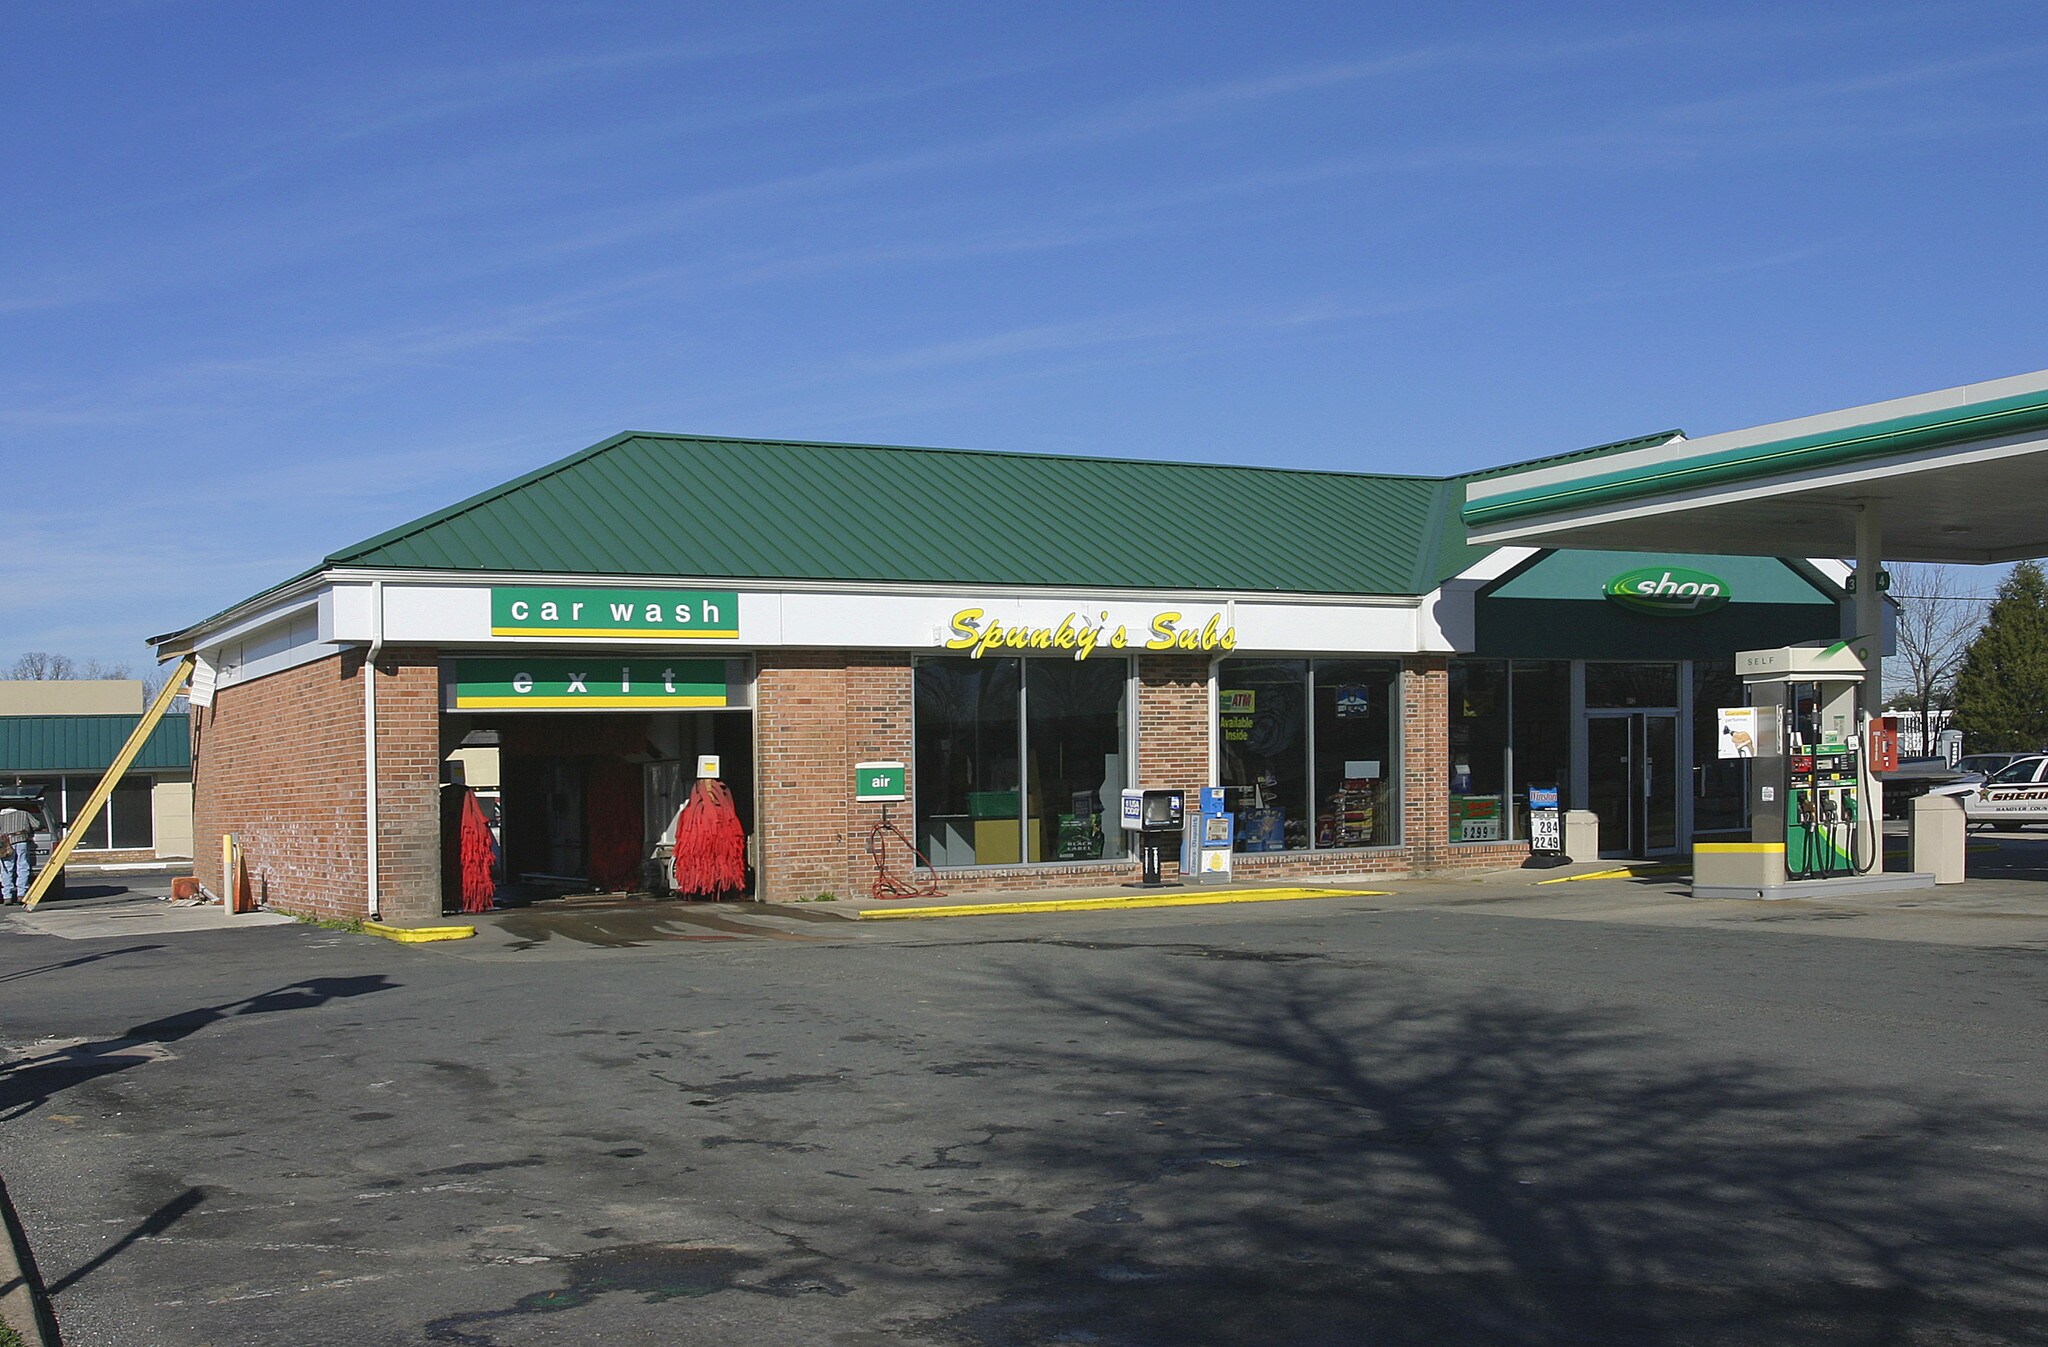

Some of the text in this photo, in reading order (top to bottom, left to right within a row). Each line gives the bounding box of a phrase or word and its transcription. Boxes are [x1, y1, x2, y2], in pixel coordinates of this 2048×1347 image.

[1849, 578, 1855, 590] 3
[1878, 575, 1885, 587] 4
[1637, 572, 1720, 607] shop
[510, 600, 720, 623] car wash
[946, 608, 1238, 661] Spunky's Subs
[1747, 656, 1774, 666] SELF
[512, 667, 676, 693] exit
[1232, 693, 1252, 707] ATM
[1220, 716, 1253, 728] Available
[1225, 729, 1248, 740] Inside
[871, 774, 891, 788] air
